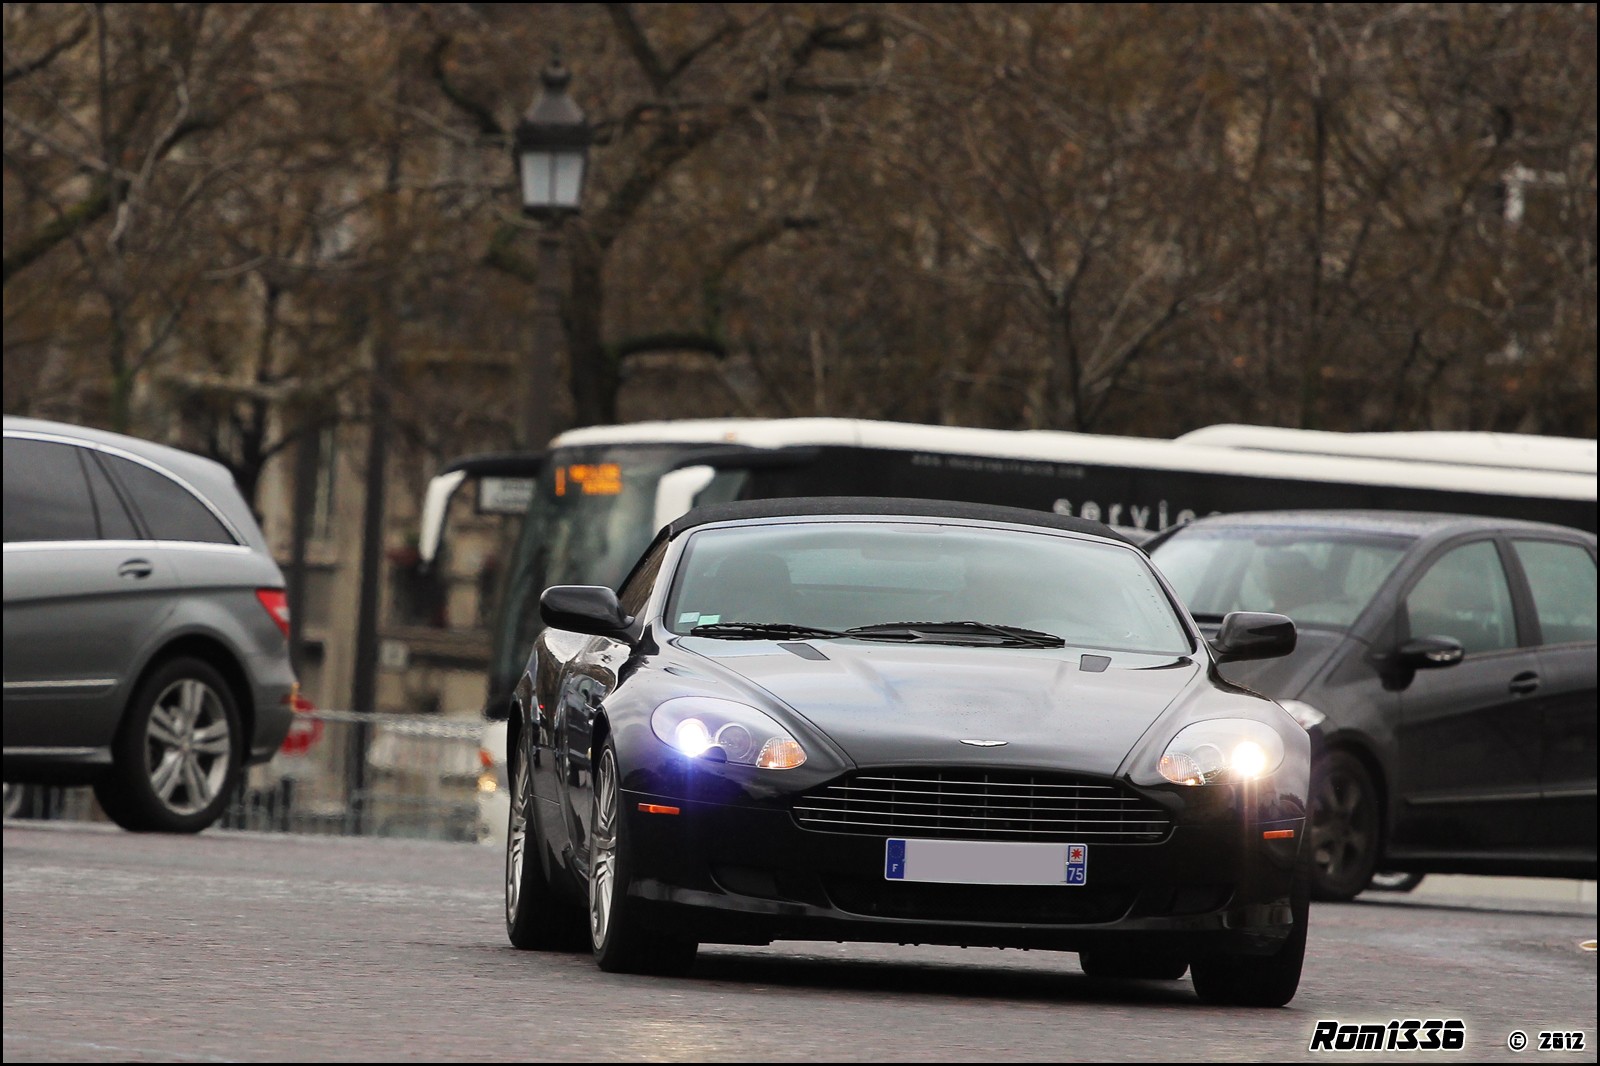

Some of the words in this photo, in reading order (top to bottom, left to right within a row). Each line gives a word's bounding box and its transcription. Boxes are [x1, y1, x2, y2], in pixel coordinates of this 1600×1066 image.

[1053, 498, 1222, 531] servic
[892, 863, 899, 872] F
[1068, 867, 1084, 881] 75
